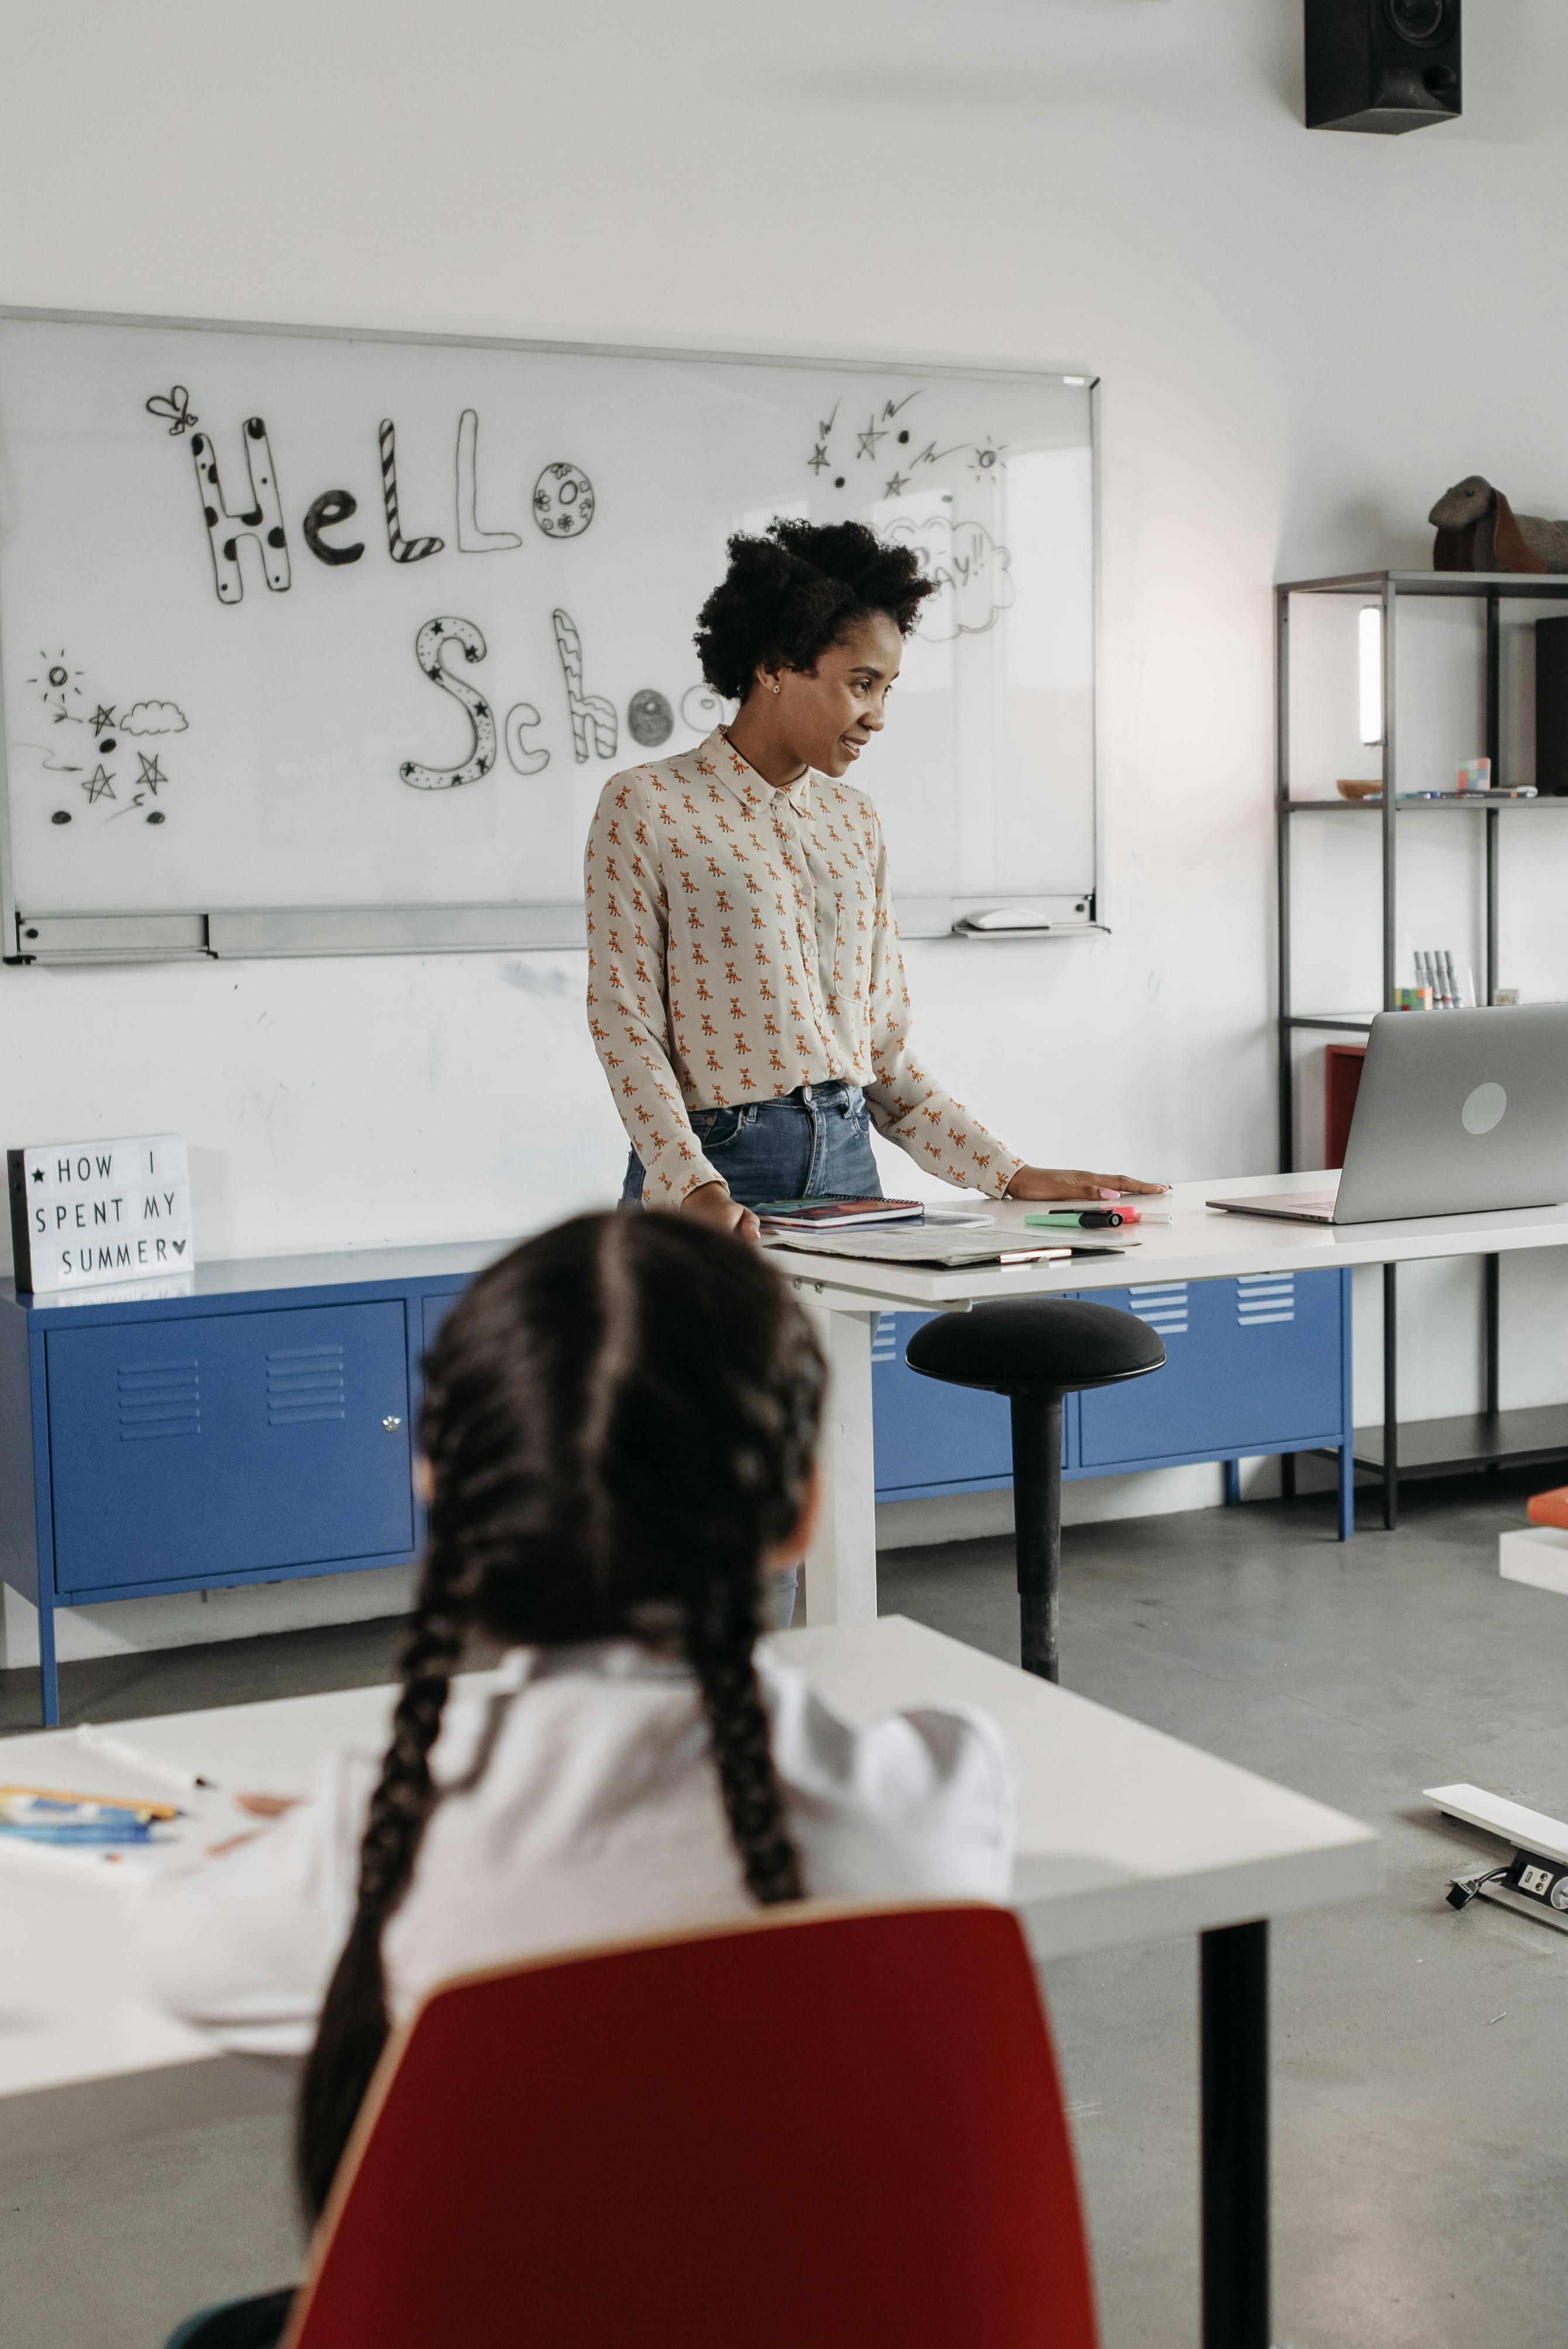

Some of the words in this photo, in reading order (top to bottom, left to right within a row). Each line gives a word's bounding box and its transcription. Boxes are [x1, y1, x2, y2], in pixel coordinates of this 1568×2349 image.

[400, 608, 725, 790] Schoo
[58, 1155, 112, 1183] HOW
[35, 1198, 123, 1233] SPENT
[144, 1192, 174, 1220] MY
[61, 1239, 168, 1274] SUMMER
